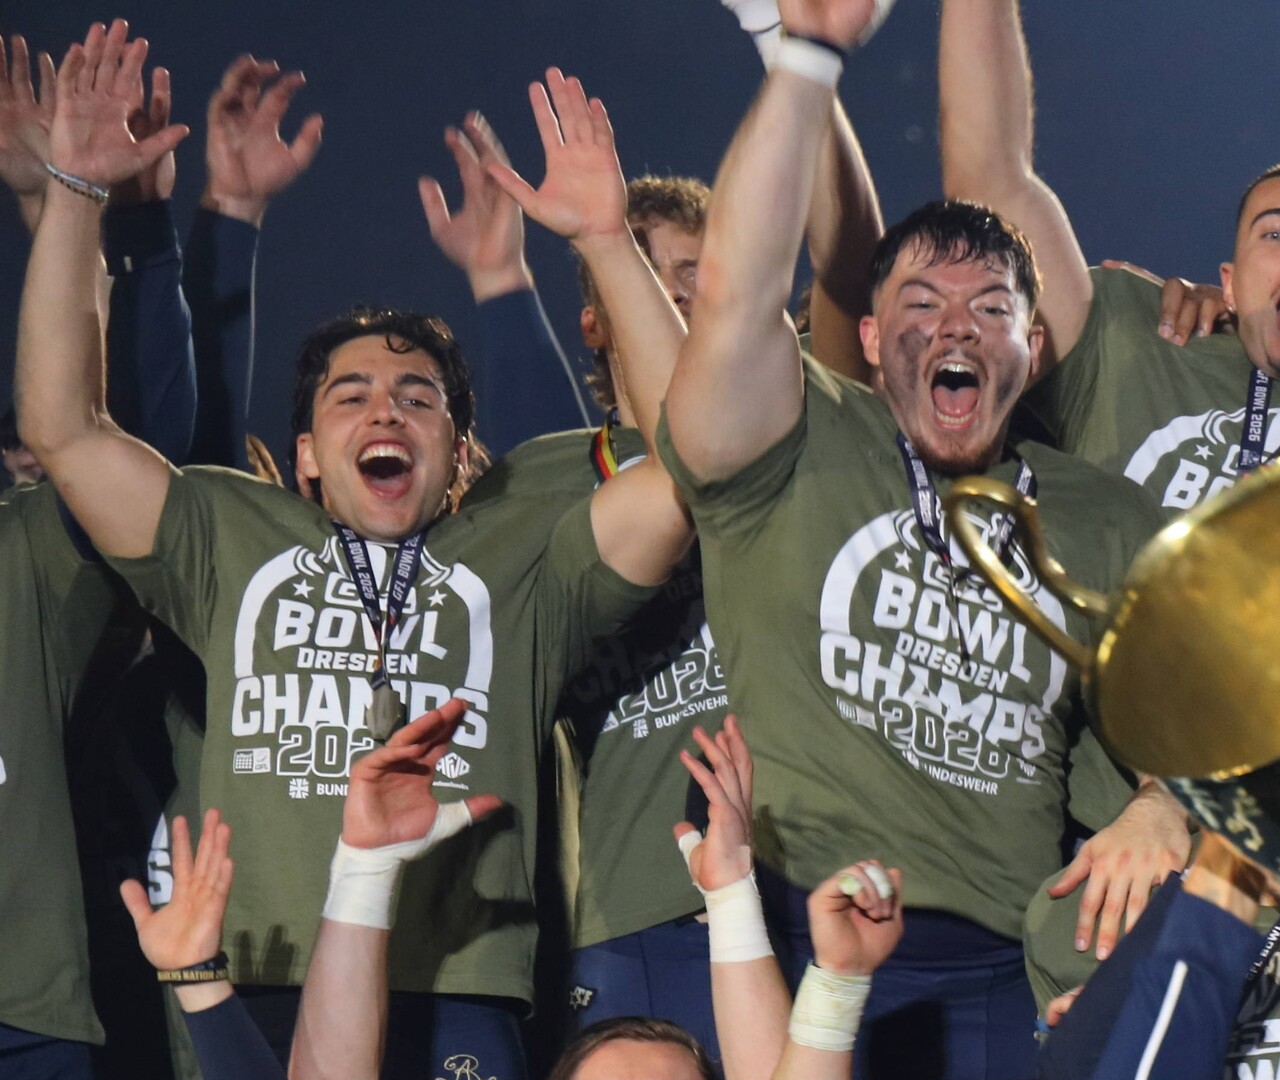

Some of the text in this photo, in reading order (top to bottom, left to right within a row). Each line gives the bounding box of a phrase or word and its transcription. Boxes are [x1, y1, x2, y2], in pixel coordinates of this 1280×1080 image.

[1252, 386, 1268, 412] BOWL
[1248, 413, 1264, 442] 2026
[349, 542, 367, 570] BOWL
[397, 549, 415, 578] BOWL
[392, 580, 407, 602] GFL
[274, 598, 448, 660] BOWL
[873, 567, 1031, 684] BOWL
[895, 632, 1008, 695] DRESDEN
[819, 632, 1047, 760] CHAMPS
